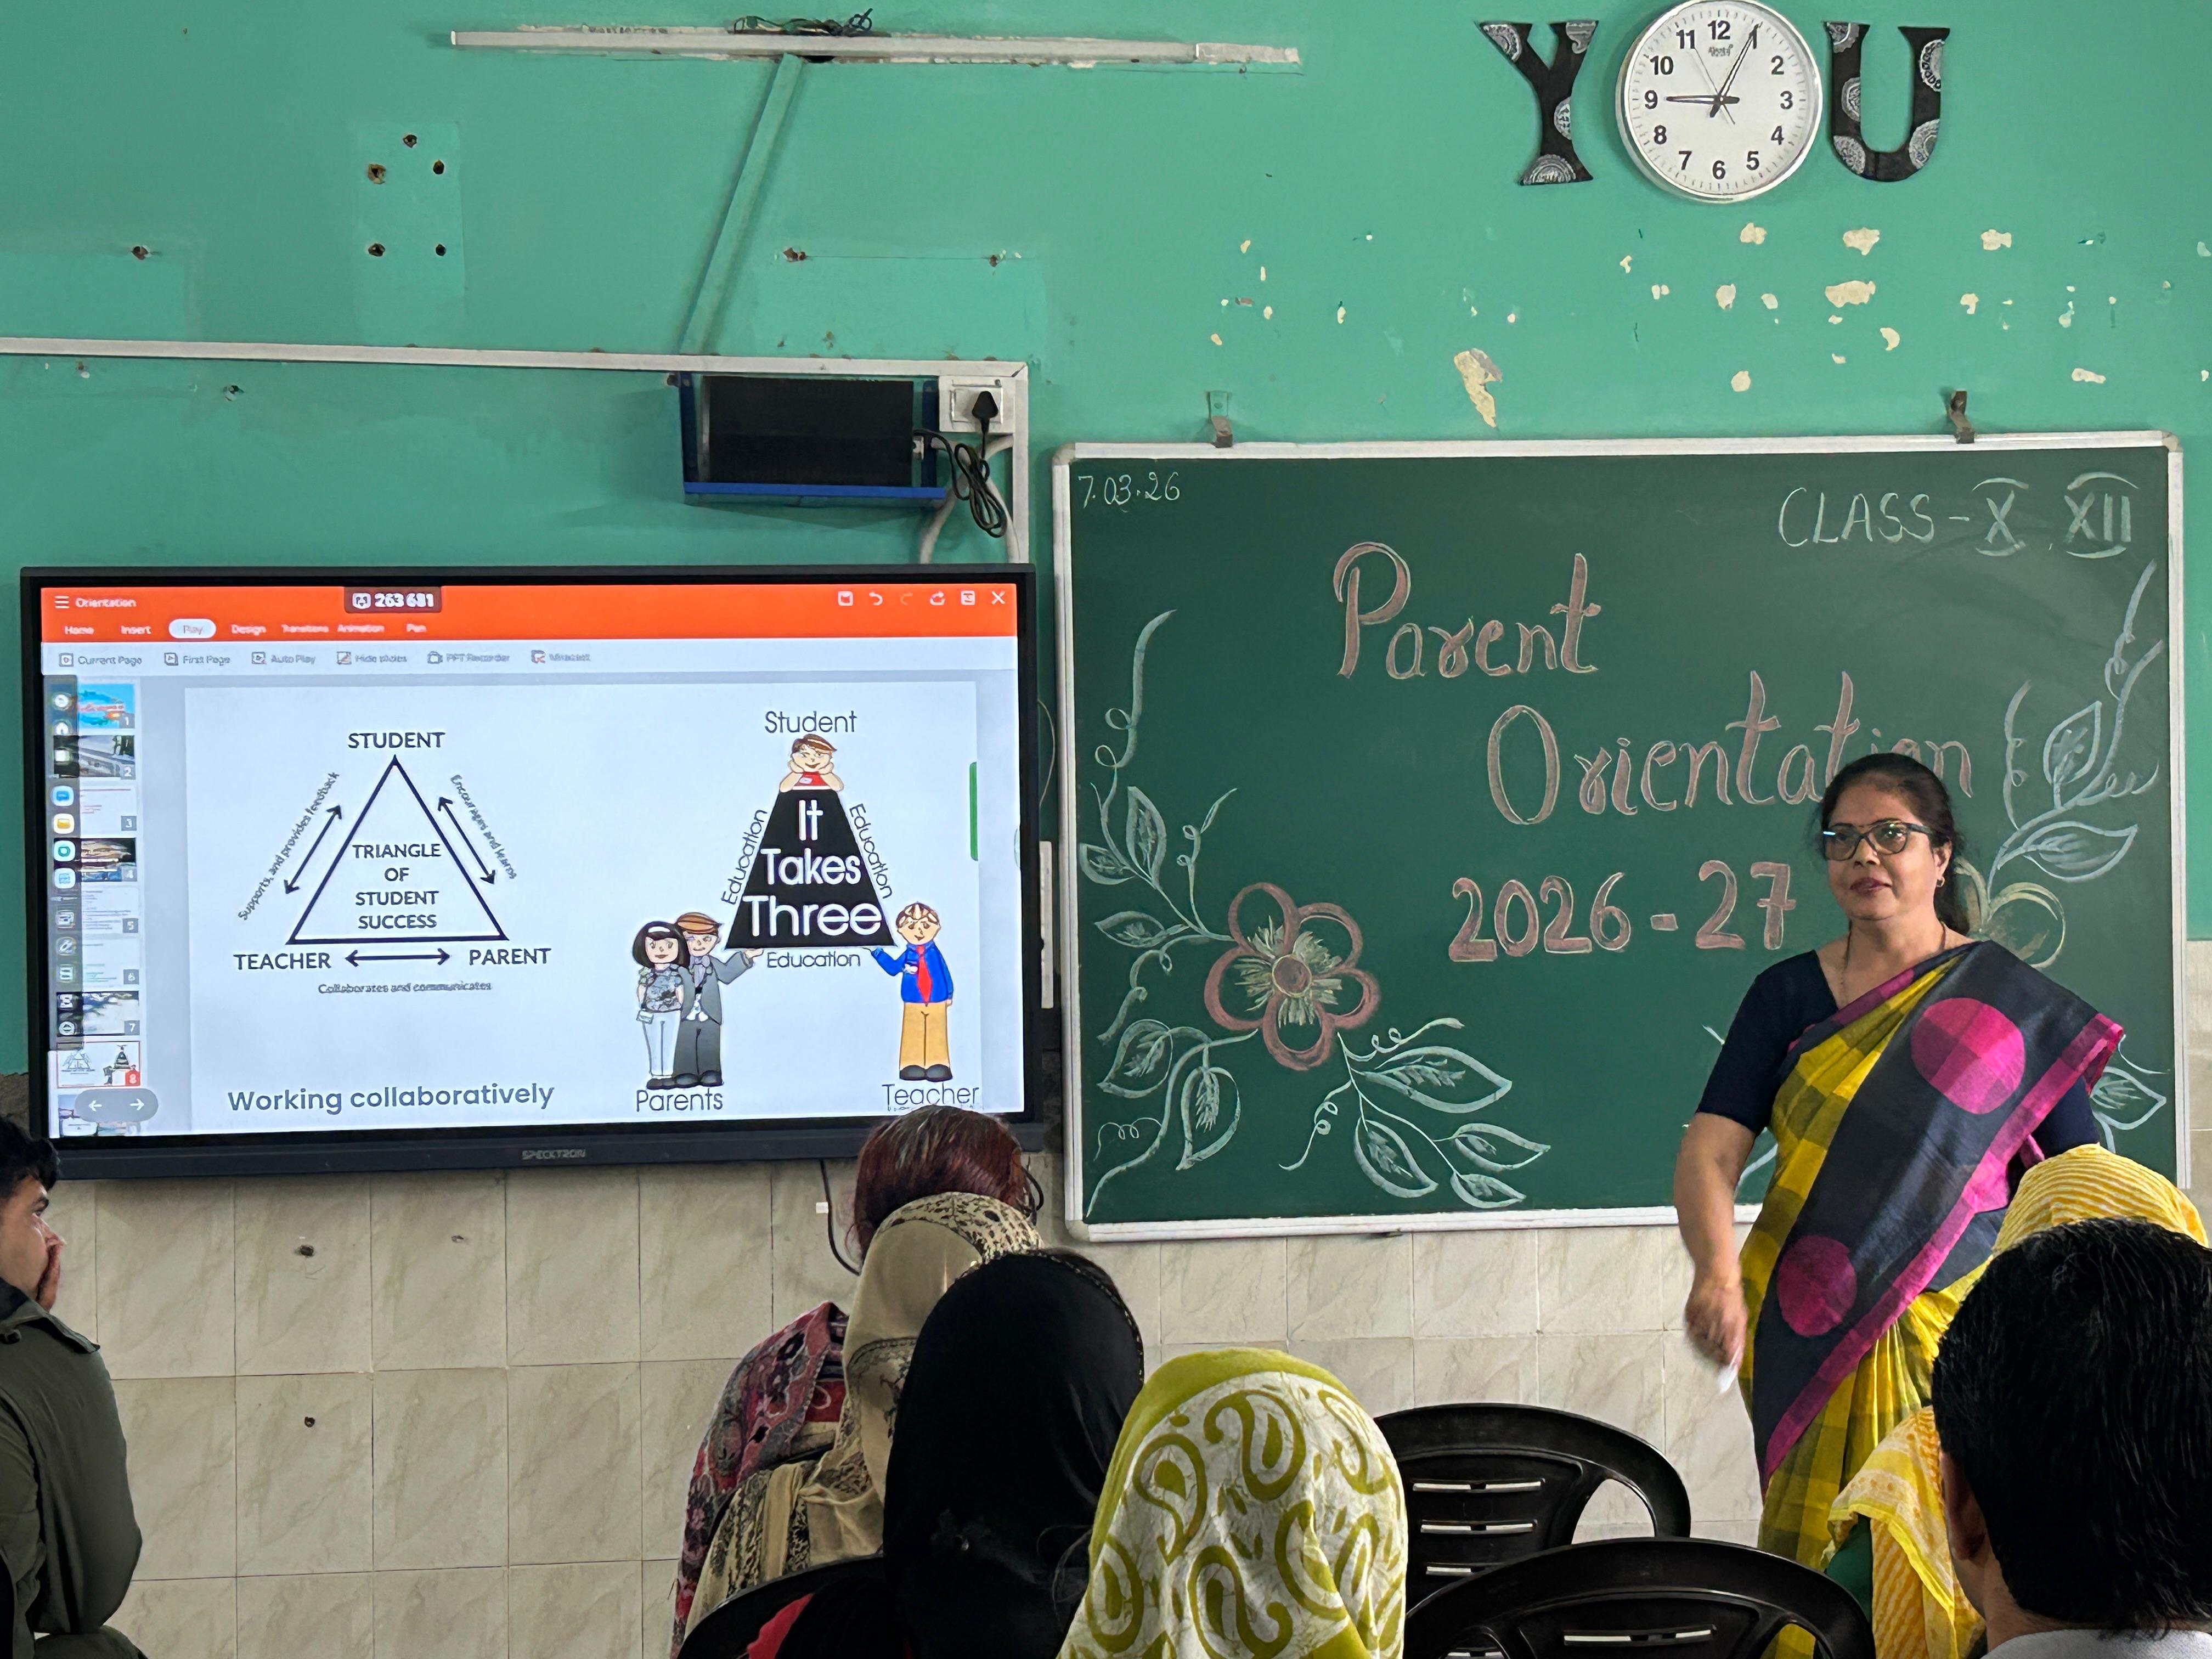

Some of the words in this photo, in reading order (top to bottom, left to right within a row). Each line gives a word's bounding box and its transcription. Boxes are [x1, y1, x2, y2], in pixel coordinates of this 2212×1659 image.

[1676, 30, 1695, 49] 11
[1708, 20, 1730, 40] 12
[1650, 56, 1674, 75] 10
[1771, 55, 1784, 75] 2
[1478, 20, 1599, 187] Y
[1822, 20, 1950, 182] U
[1644, 90, 1658, 109] 9
[1780, 91, 1793, 110] 3
[1654, 125, 1667, 144] 8
[1771, 126, 1784, 145] 4
[1678, 151, 1692, 170] 7
[1712, 160, 1726, 179] 6
[1746, 151, 1759, 170] 5
[2064, 471, 2139, 558] XII
[76, 597, 137, 608] Orientation
[1333, 541, 1601, 679] Parent
[64, 626, 94, 635] Home
[121, 625, 151, 634] Insert
[231, 624, 267, 636] Design
[78, 656, 116, 665] Current
[118, 656, 143, 667] Page
[183, 655, 205, 664] First
[206, 656, 230, 667] Page
[765, 710, 857, 734] Student
[348, 731, 446, 749] STUDENT
[1487, 670, 1973, 825] Orientatn
[125, 768, 132, 777] 2
[125, 819, 132, 828] 3
[799, 799, 823, 841] It
[352, 842, 442, 859] TRIANGLE
[721, 809, 768, 905] Education
[849, 803, 893, 899] Education
[384, 867, 410, 882] OF
[760, 848, 861, 885] Takes
[356, 890, 439, 906] STUDENT
[358, 914, 437, 929] SUCCESS
[742, 895, 882, 936] Three
[233, 952, 332, 970] TEACHER
[469, 948, 552, 965] PARENT
[767, 951, 860, 968] Education
[318, 983, 388, 994] Collaborates
[391, 983, 411, 992] and
[129, 1023, 136, 1032] 7
[129, 1074, 137, 1084] 8
[228, 1089, 343, 1115] Working
[350, 1082, 555, 1109] collaboratively
[636, 1087, 724, 1111] Parents
[882, 1082, 979, 1106] Teacher
